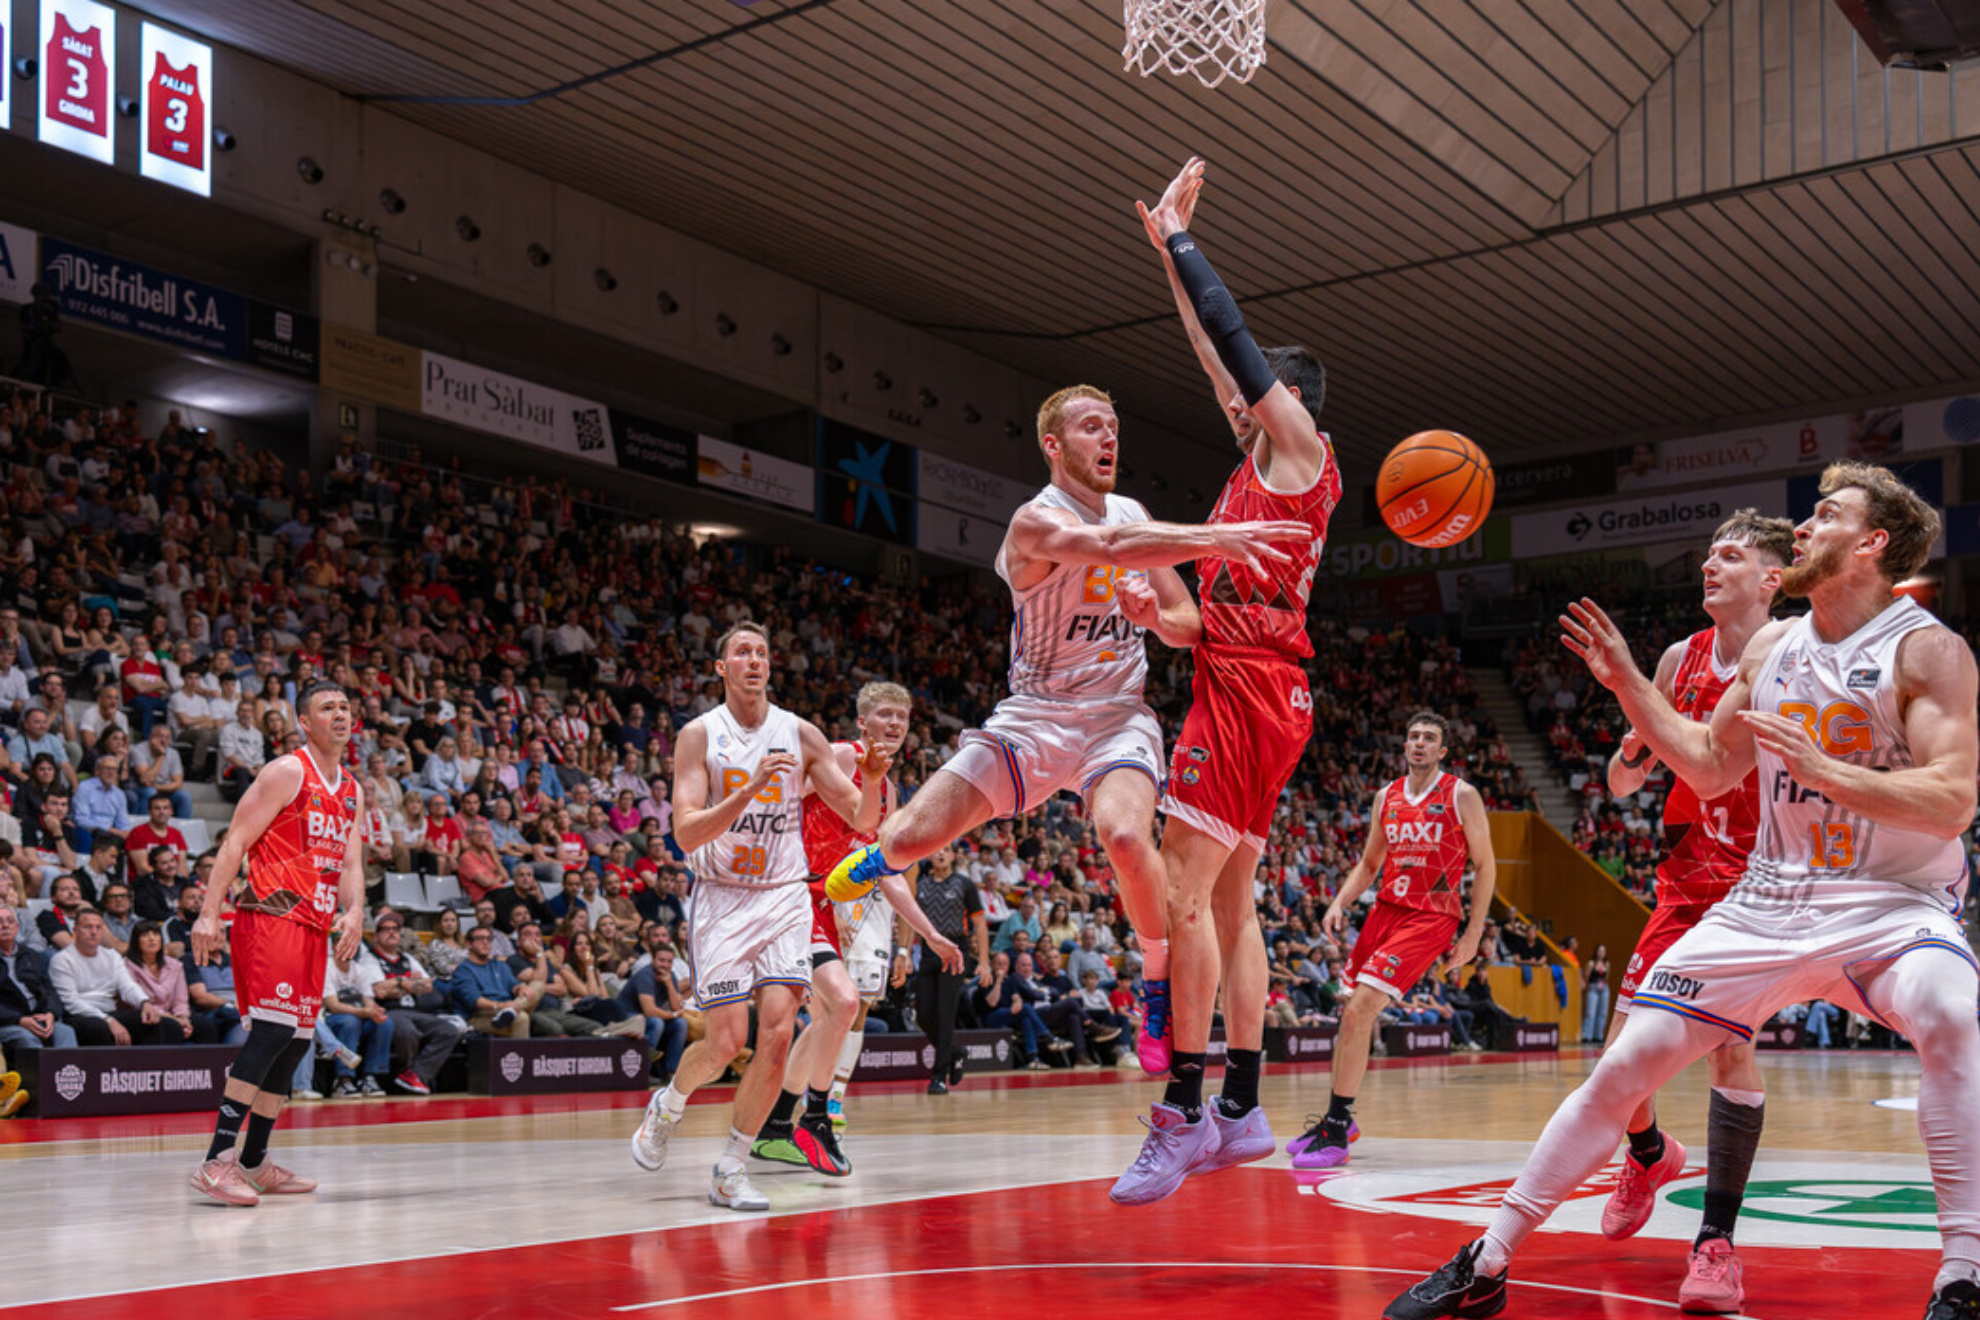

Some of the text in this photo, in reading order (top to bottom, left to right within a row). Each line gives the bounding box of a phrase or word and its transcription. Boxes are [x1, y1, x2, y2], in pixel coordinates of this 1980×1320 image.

[67, 58, 88, 98] 3
[165, 98, 188, 133] 3
[74, 256, 227, 331] Disfribell S.A.
[1664, 445, 1752, 475] FRISELVA
[1598, 501, 1722, 533] Grabalosa
[308, 810, 353, 844] BAX
[729, 813, 788, 835] ATC
[1385, 821, 1444, 844] BAXI
[731, 845, 767, 877] 29
[1808, 822, 1857, 869] 13
[313, 881, 339, 914] 55
[1393, 874, 1412, 898] 8
[852, 903, 864, 921] 8
[707, 979, 740, 997] YOSOY
[1647, 971, 1706, 1000] YOSOY
[100, 1067, 213, 1096] BÀSQUET GIRONA
